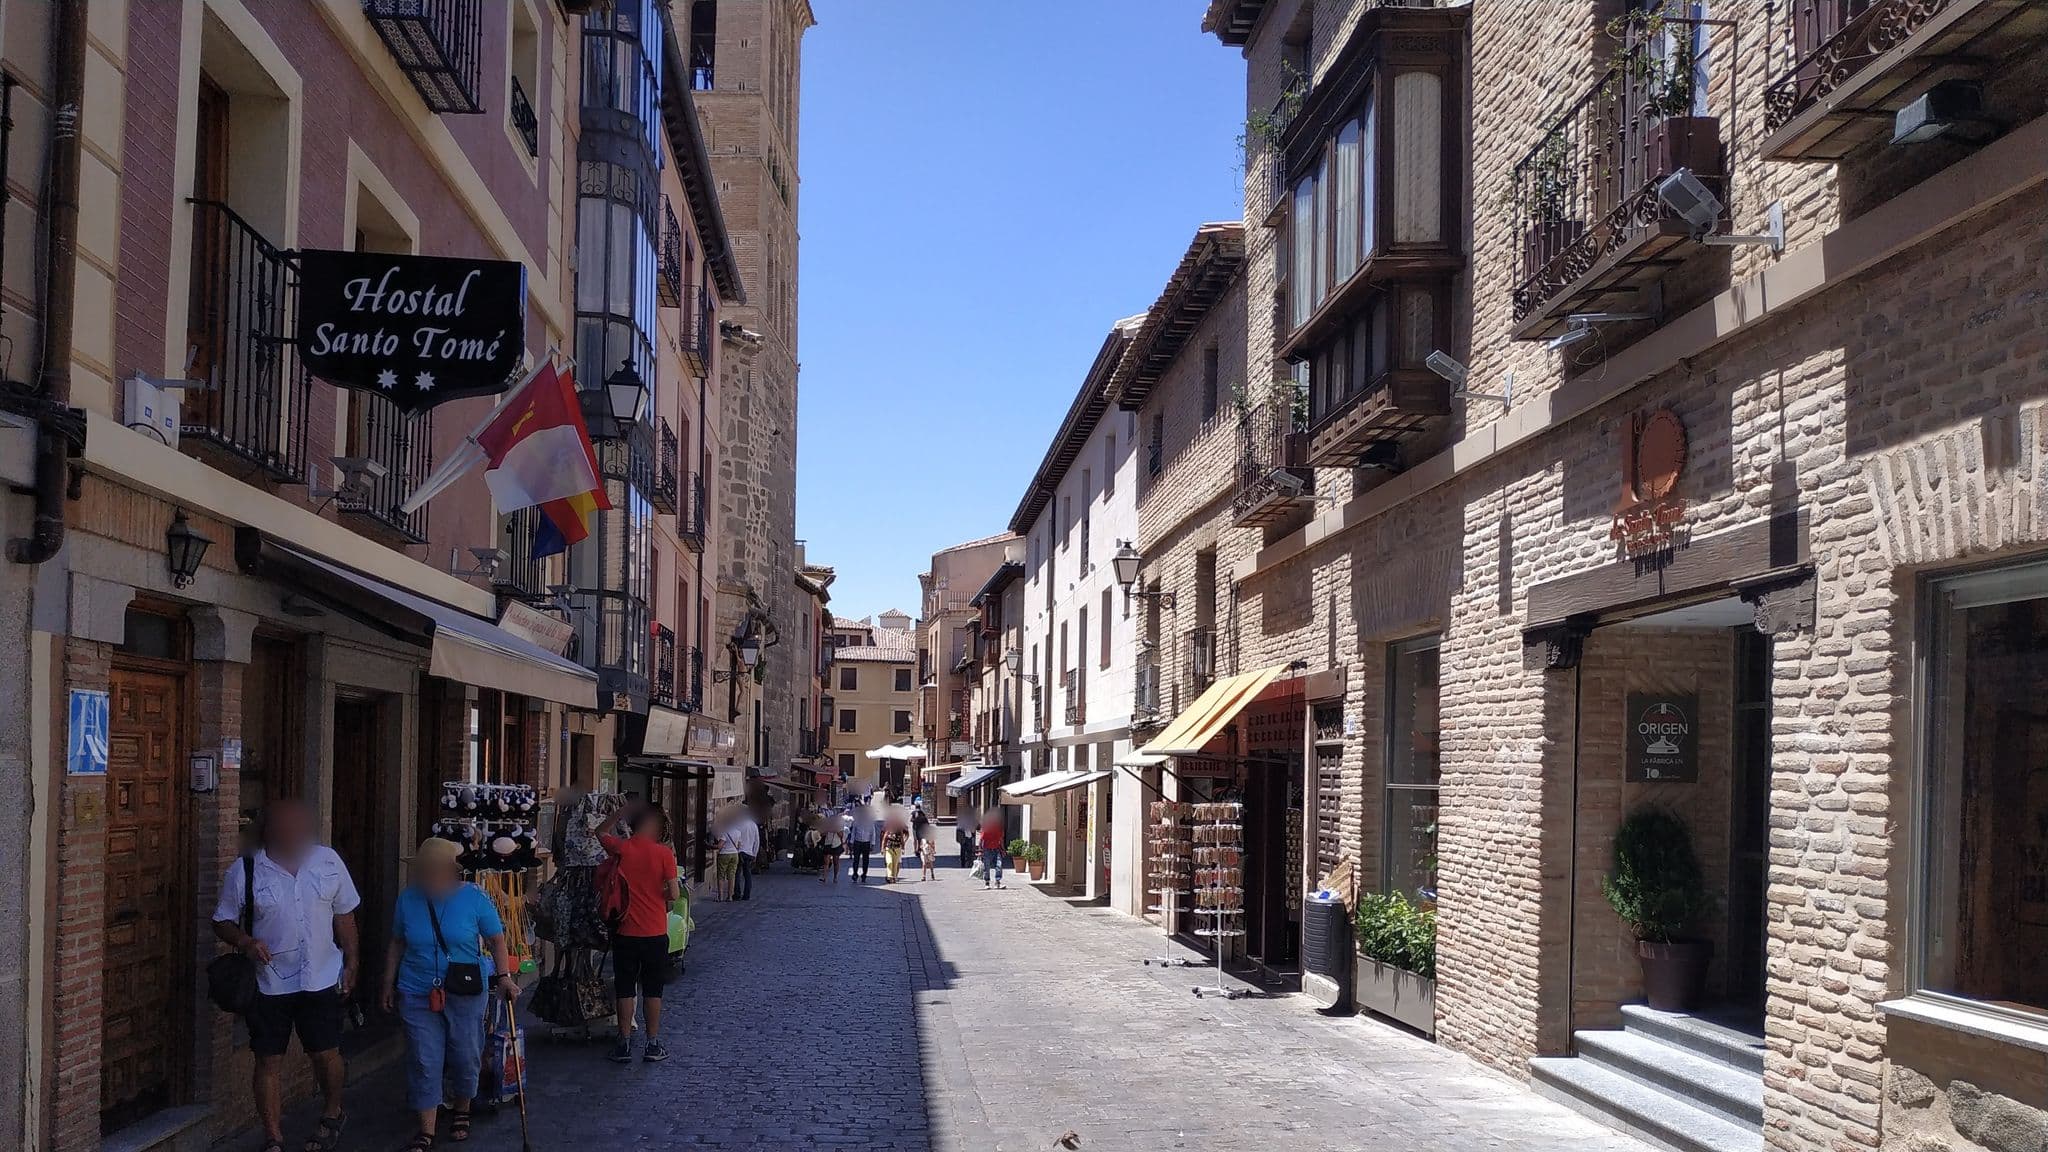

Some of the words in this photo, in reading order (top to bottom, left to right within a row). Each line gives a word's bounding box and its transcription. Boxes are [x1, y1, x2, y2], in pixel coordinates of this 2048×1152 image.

[344, 266, 481, 317] Hostal
[310, 322, 399, 356] Santo
[413, 326, 506, 362] Tomé
[1638, 722, 1689, 735] ORIGEN
